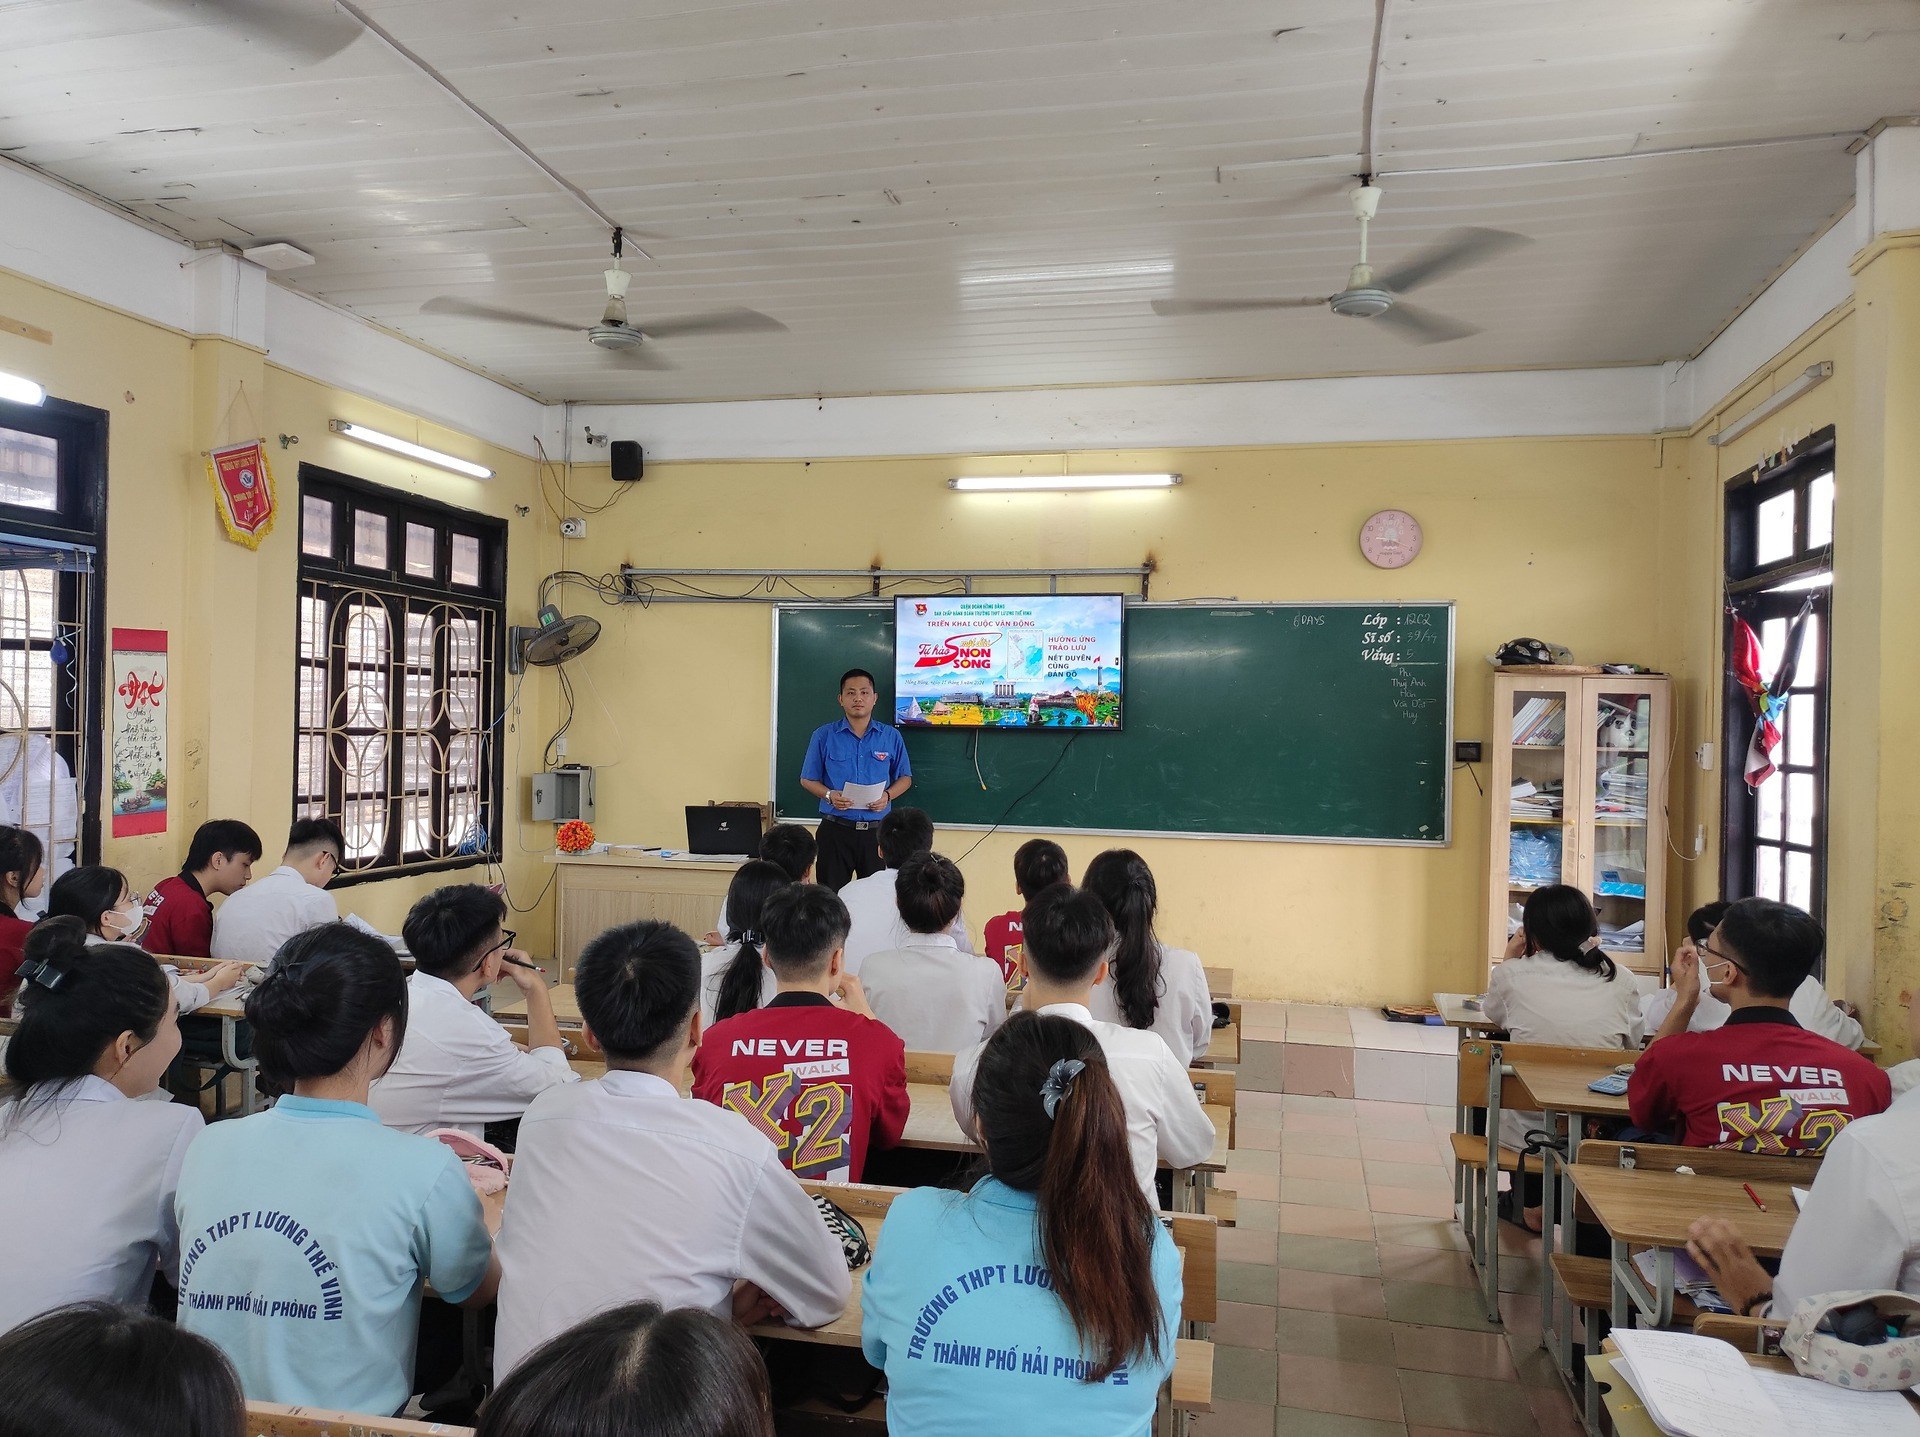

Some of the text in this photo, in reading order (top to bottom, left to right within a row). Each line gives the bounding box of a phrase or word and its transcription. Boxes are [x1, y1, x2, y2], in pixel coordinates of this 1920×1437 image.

[973, 620, 993, 628] CUỘC
[1013, 620, 1035, 628] ĐỘNG
[1362, 612, 1388, 629] Lớp
[1362, 631, 1376, 644] Sĩ
[1378, 630, 1394, 644] số
[960, 648, 991, 658] NON
[731, 1038, 849, 1057] NEVER
[789, 1062, 842, 1076] WALK
[1722, 1064, 1844, 1087] NEVER
[1789, 1091, 1842, 1102] WALK
[206, 1212, 251, 1243] THPT
[254, 1210, 309, 1246] LƯƠNG
[304, 1240, 338, 1278] THẾ
[188, 1290, 318, 1320] THÀNH PHỐ HẢI PHÒNG
[320, 1276, 343, 1321] VINH
[906, 1284, 960, 1360] TRƯỜNG
[957, 1264, 1006, 1294] THPT
[933, 1340, 982, 1367] THÀNH
[985, 1344, 1020, 1372] PHỐ
[1021, 1346, 1048, 1376] HẢI
